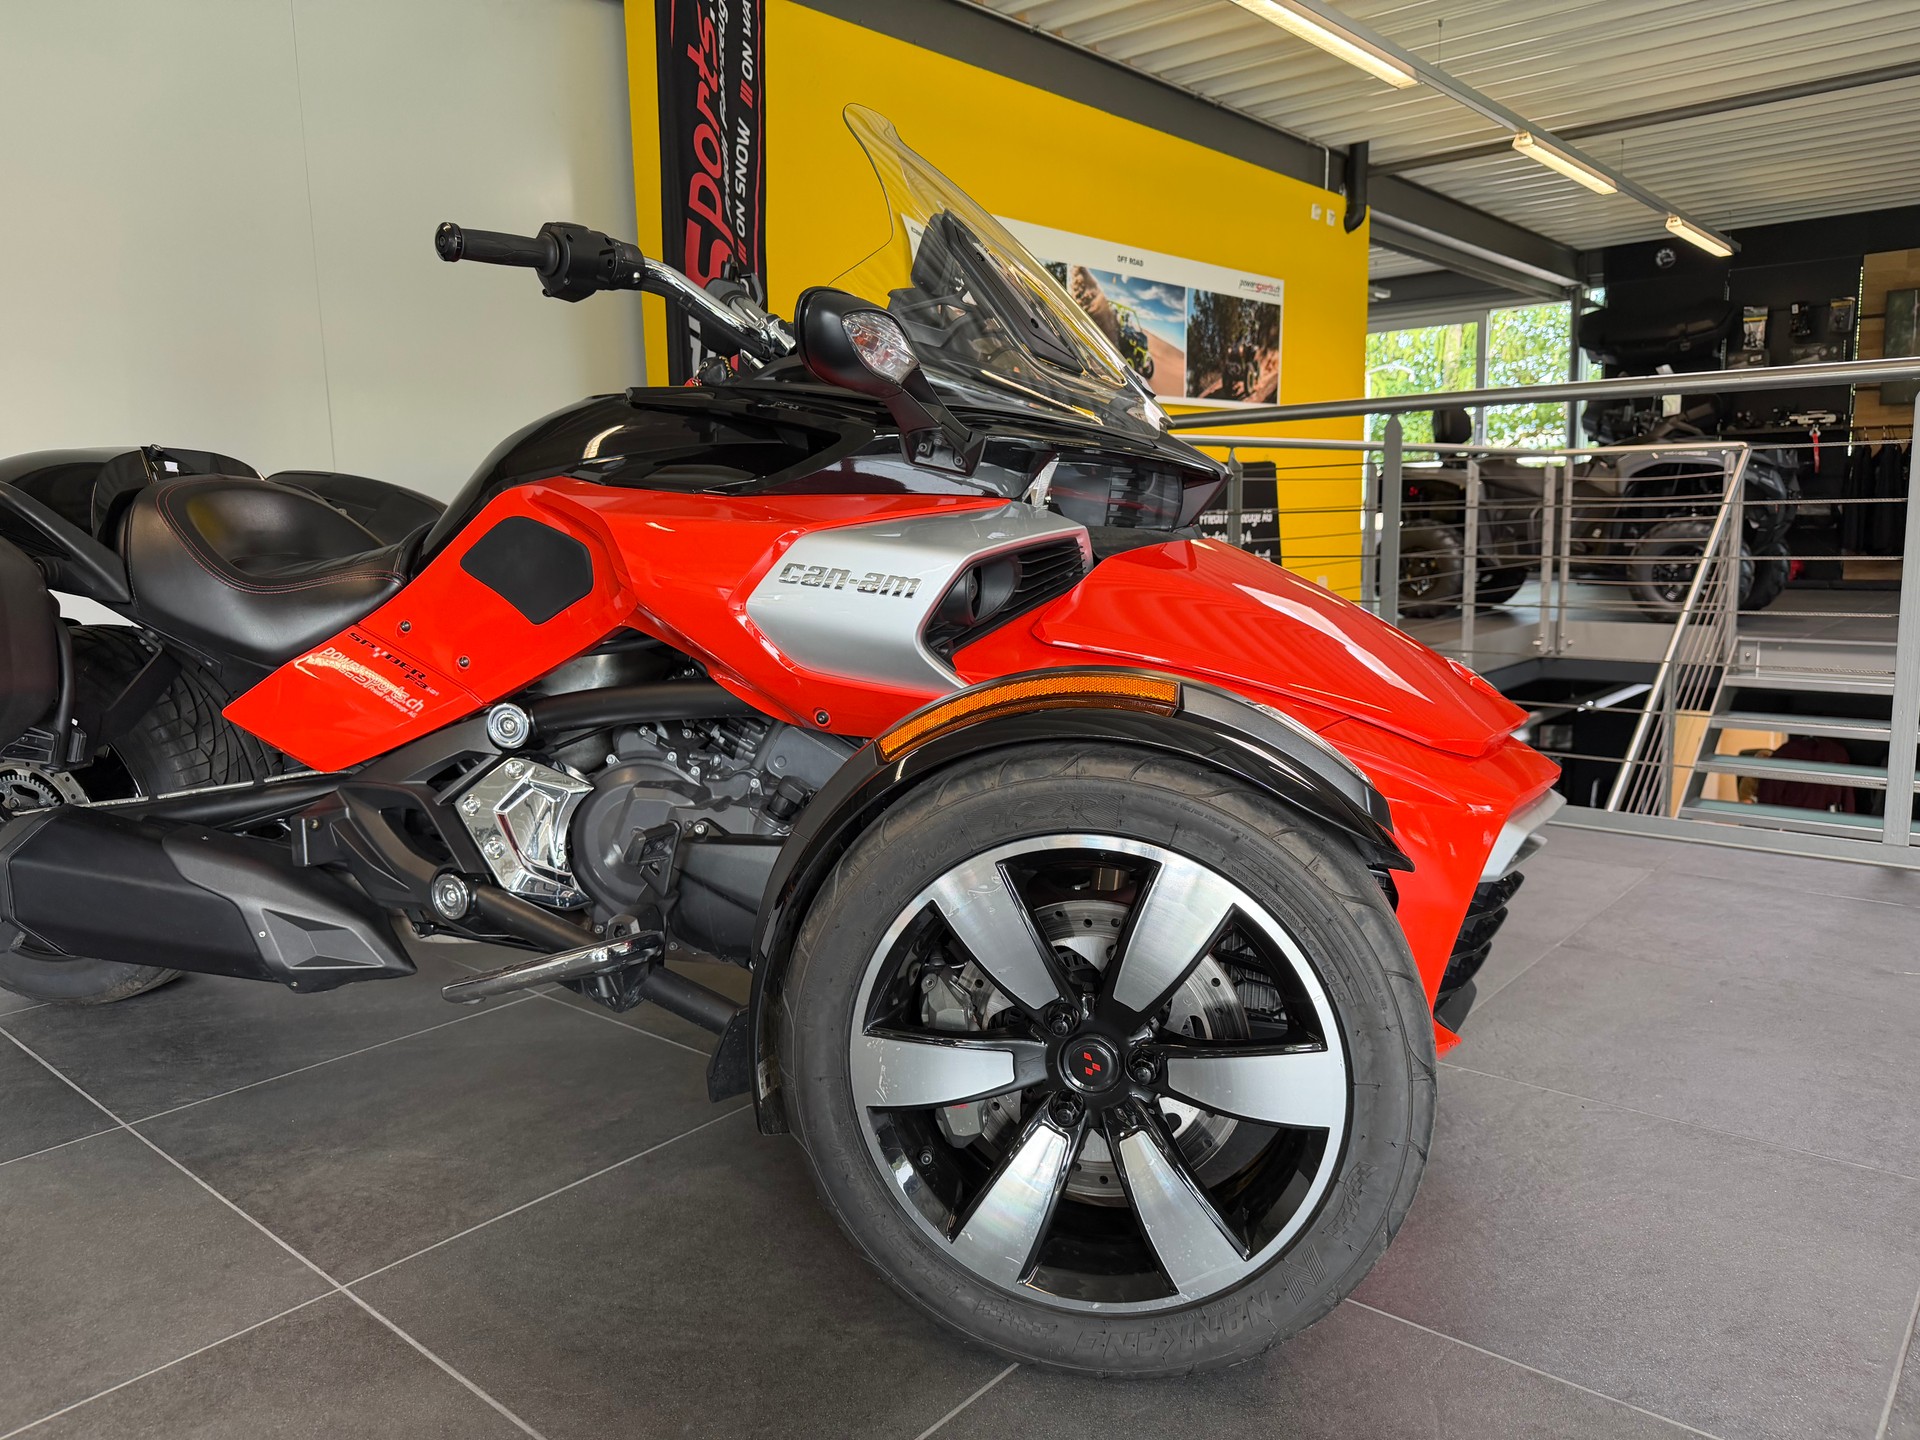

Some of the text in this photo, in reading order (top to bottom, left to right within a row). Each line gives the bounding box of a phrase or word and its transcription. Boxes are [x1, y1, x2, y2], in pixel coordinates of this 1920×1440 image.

[741, 40, 754, 81] ON
[734, 116, 751, 238] ON SNOW
[1117, 255, 1144, 267] OFF ROAD
[778, 562, 923, 599] can-am
[348, 632, 427, 681] SPYDER
